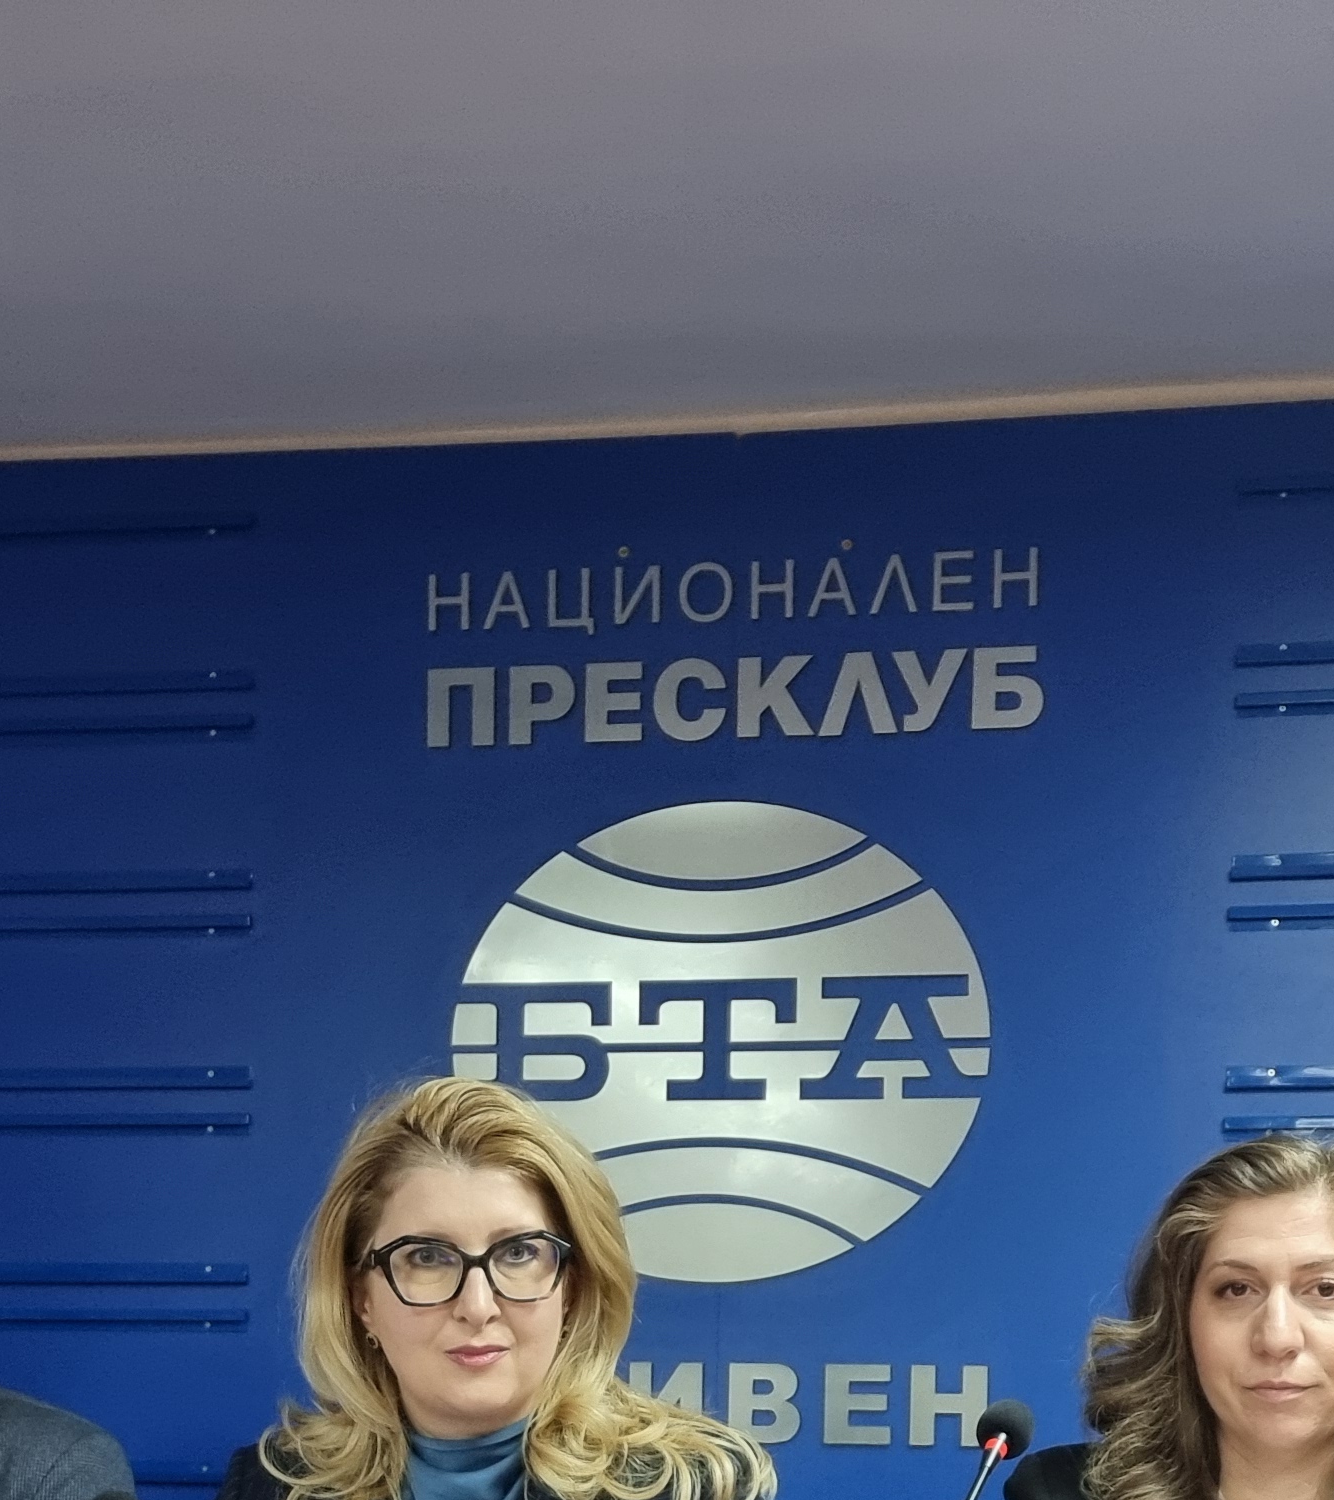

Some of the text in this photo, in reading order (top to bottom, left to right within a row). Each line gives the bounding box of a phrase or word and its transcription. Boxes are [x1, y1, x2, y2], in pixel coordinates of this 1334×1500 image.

[427, 547, 1039, 635] НАЦИОНАЛЕН
[426, 645, 1045, 747] ПРЕСКЛУБ
[462, 974, 981, 1101] БТА
[628, 1361, 989, 1447] ИВЕН
